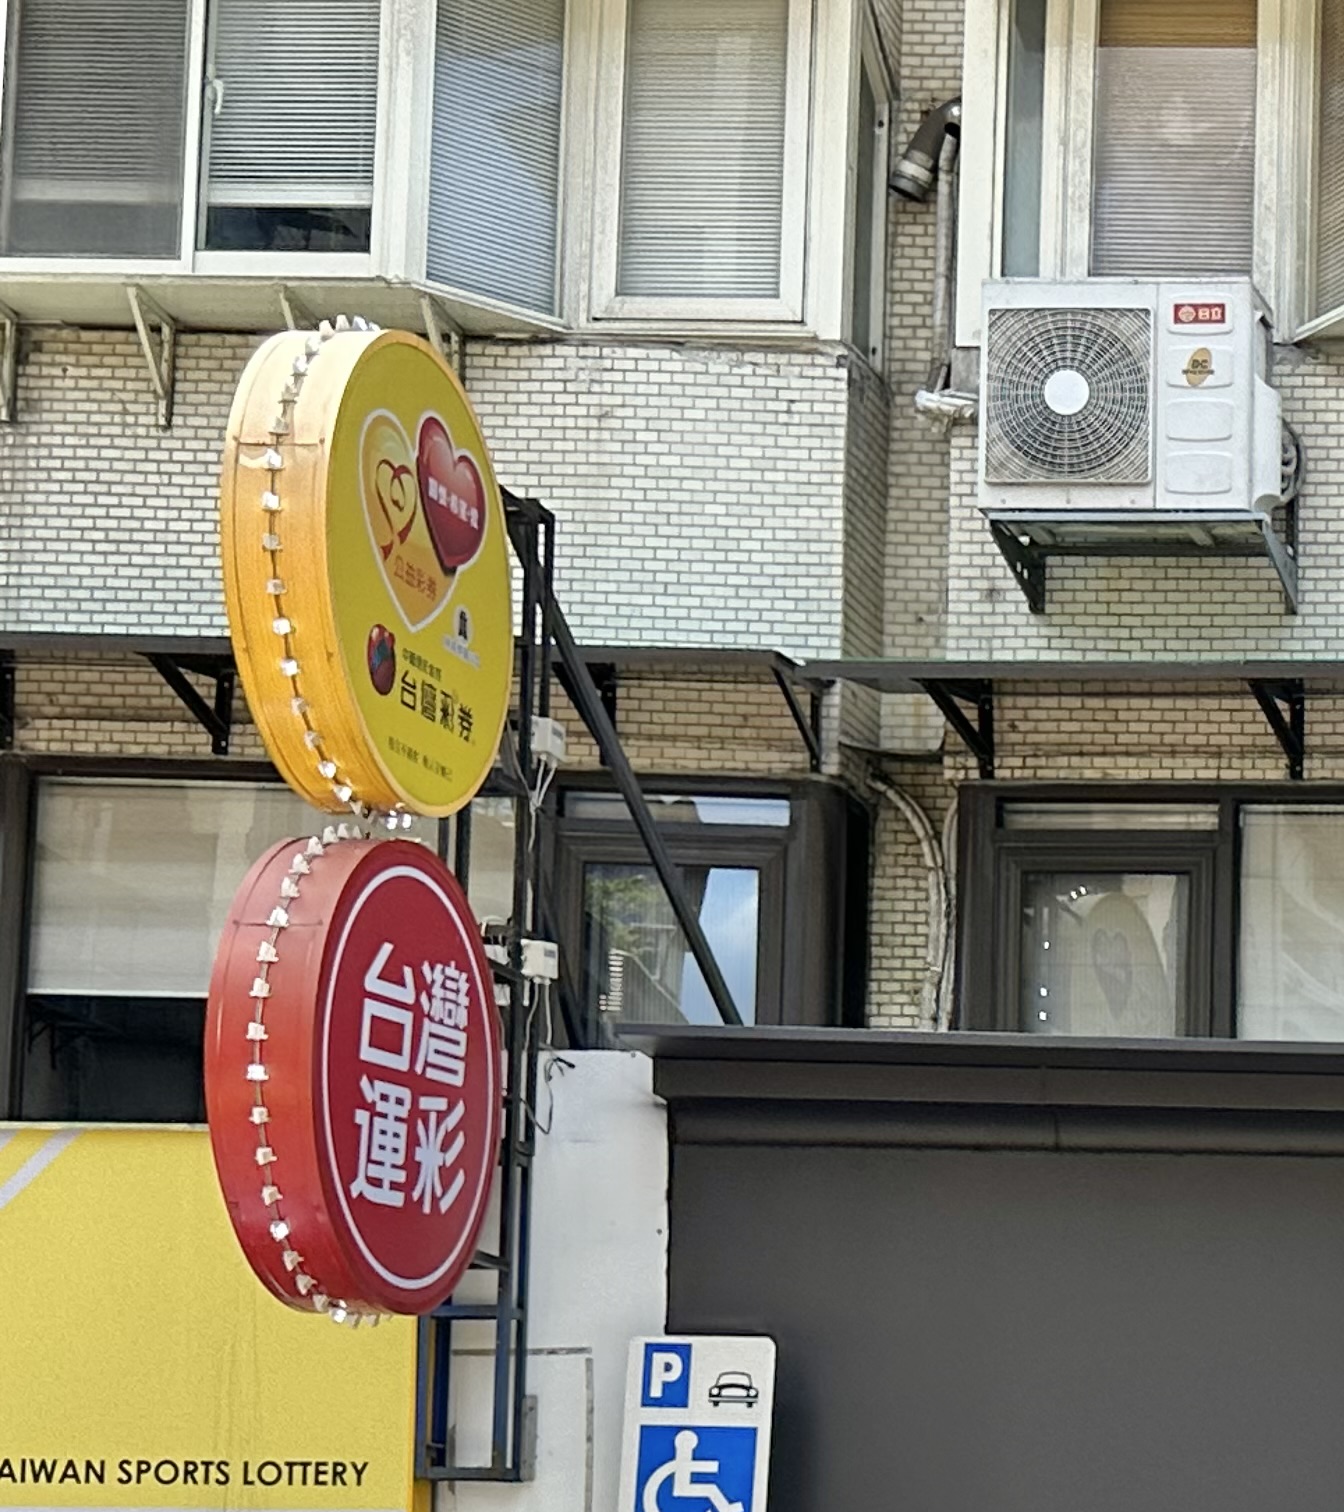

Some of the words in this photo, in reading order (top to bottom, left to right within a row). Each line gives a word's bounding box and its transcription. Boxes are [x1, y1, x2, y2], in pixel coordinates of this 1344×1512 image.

[1191, 359, 1209, 370] DC
[649, 1352, 683, 1399] P
[117, 1459, 230, 1486] SPORTS
[243, 1460, 369, 1487] LOTTERY
